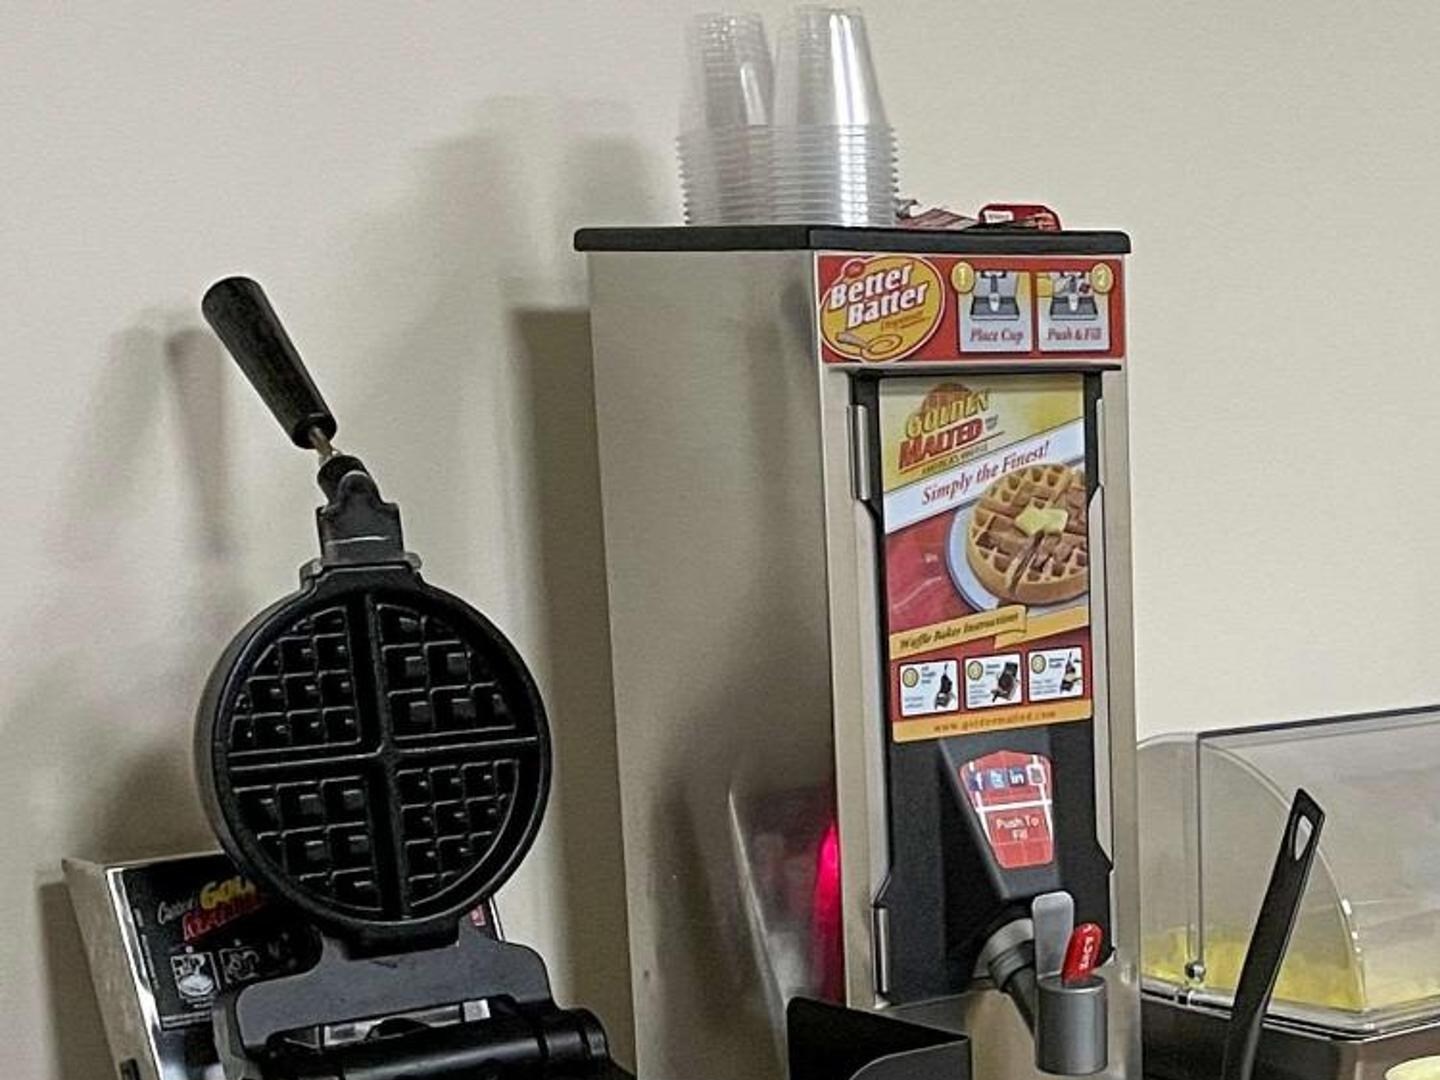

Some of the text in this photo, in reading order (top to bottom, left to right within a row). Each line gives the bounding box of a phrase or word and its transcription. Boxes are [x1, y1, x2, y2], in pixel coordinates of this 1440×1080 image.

[830, 264, 914, 310] Better
[847, 283, 928, 329] Batter
[970, 328, 1024, 344] Place Cup
[1047, 327, 1072, 341] Push
[1083, 327, 1102, 341] Fill
[899, 417, 984, 470] MALTED
[922, 471, 974, 505] Simply
[976, 462, 1000, 483] the
[1002, 440, 1051, 473] Finest!
